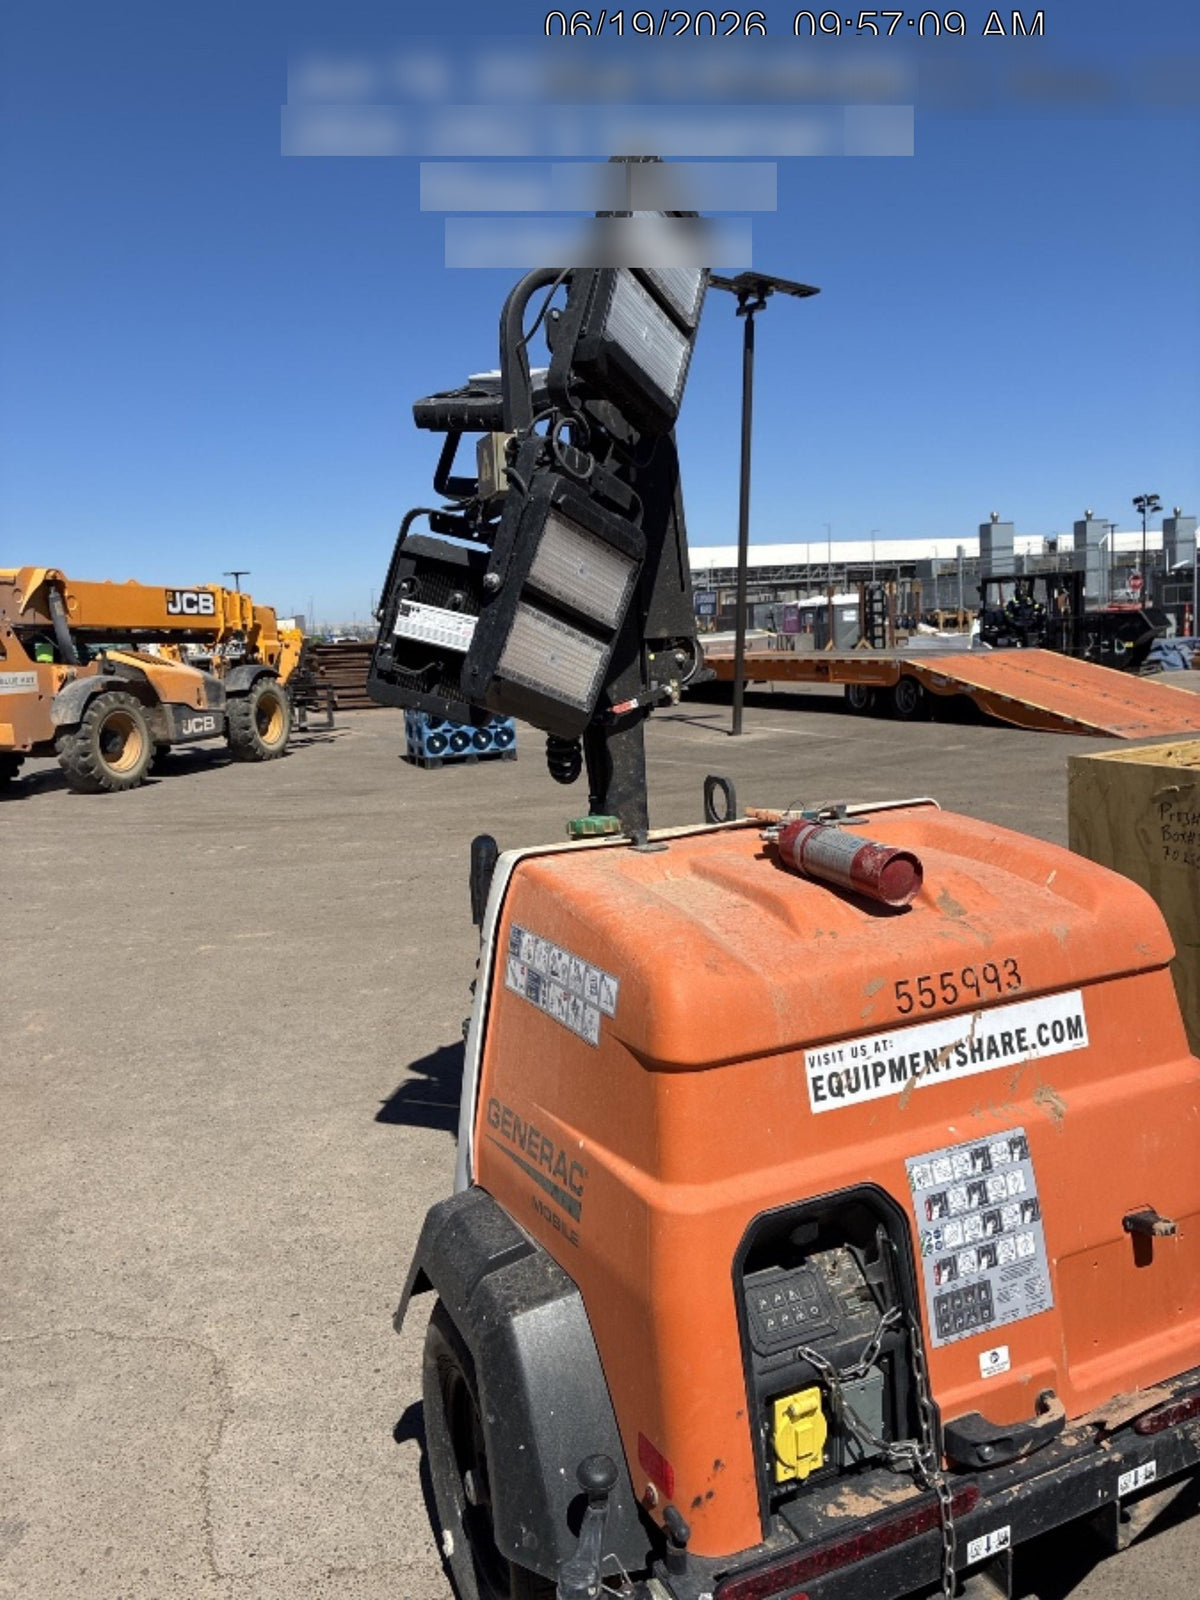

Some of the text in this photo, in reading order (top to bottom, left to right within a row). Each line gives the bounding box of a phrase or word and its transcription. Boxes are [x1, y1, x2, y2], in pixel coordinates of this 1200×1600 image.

[167, 591, 214, 614] JCB
[182, 716, 215, 734] JCB
[894, 958, 1022, 1014] 555993
[808, 1040, 893, 1068] VISIT US AT:
[811, 1014, 1084, 1102] EQUIPMENTSHARE.COM
[487, 1098, 584, 1197] GENERAC
[531, 1195, 579, 1248] MOBILE
